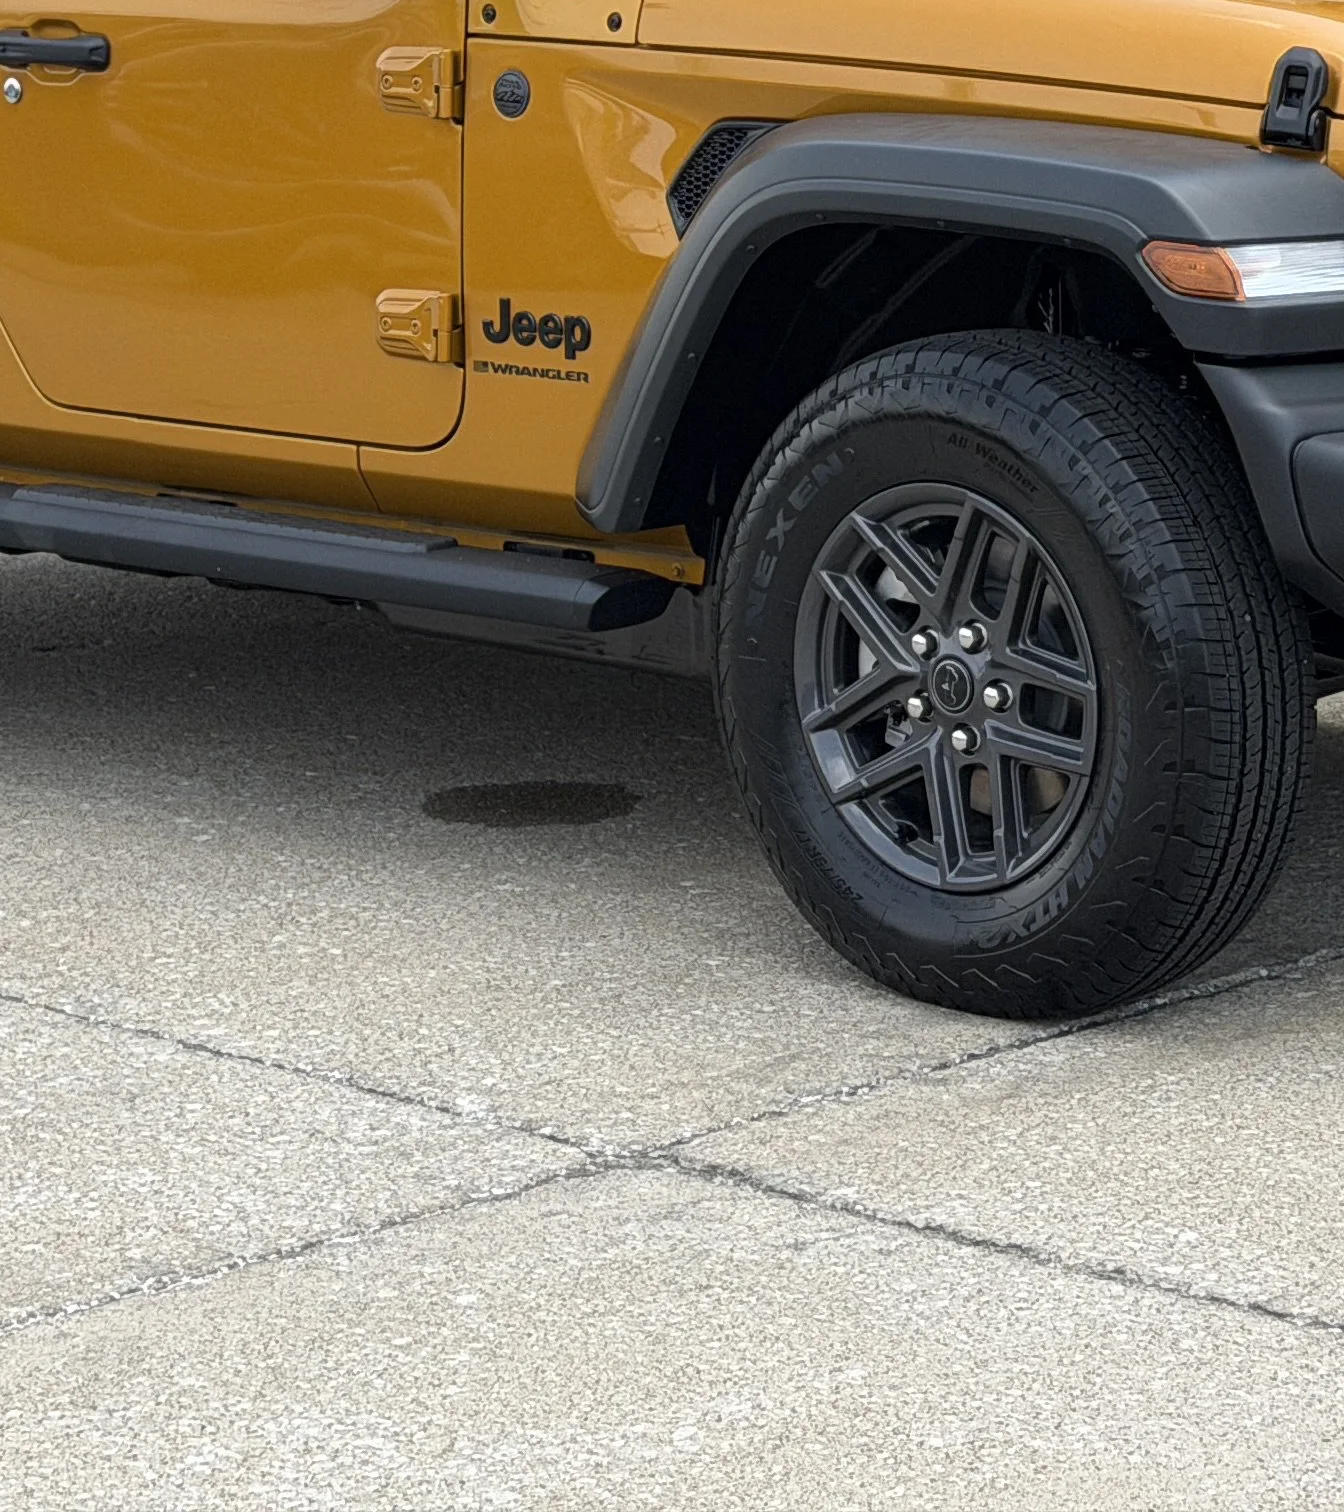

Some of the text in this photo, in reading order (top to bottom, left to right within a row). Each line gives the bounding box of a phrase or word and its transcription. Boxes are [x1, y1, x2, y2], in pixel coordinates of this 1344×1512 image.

[482, 297, 592, 360] Jeep
[490, 361, 589, 384] WRANGLER
[745, 451, 844, 630] NEXEN
